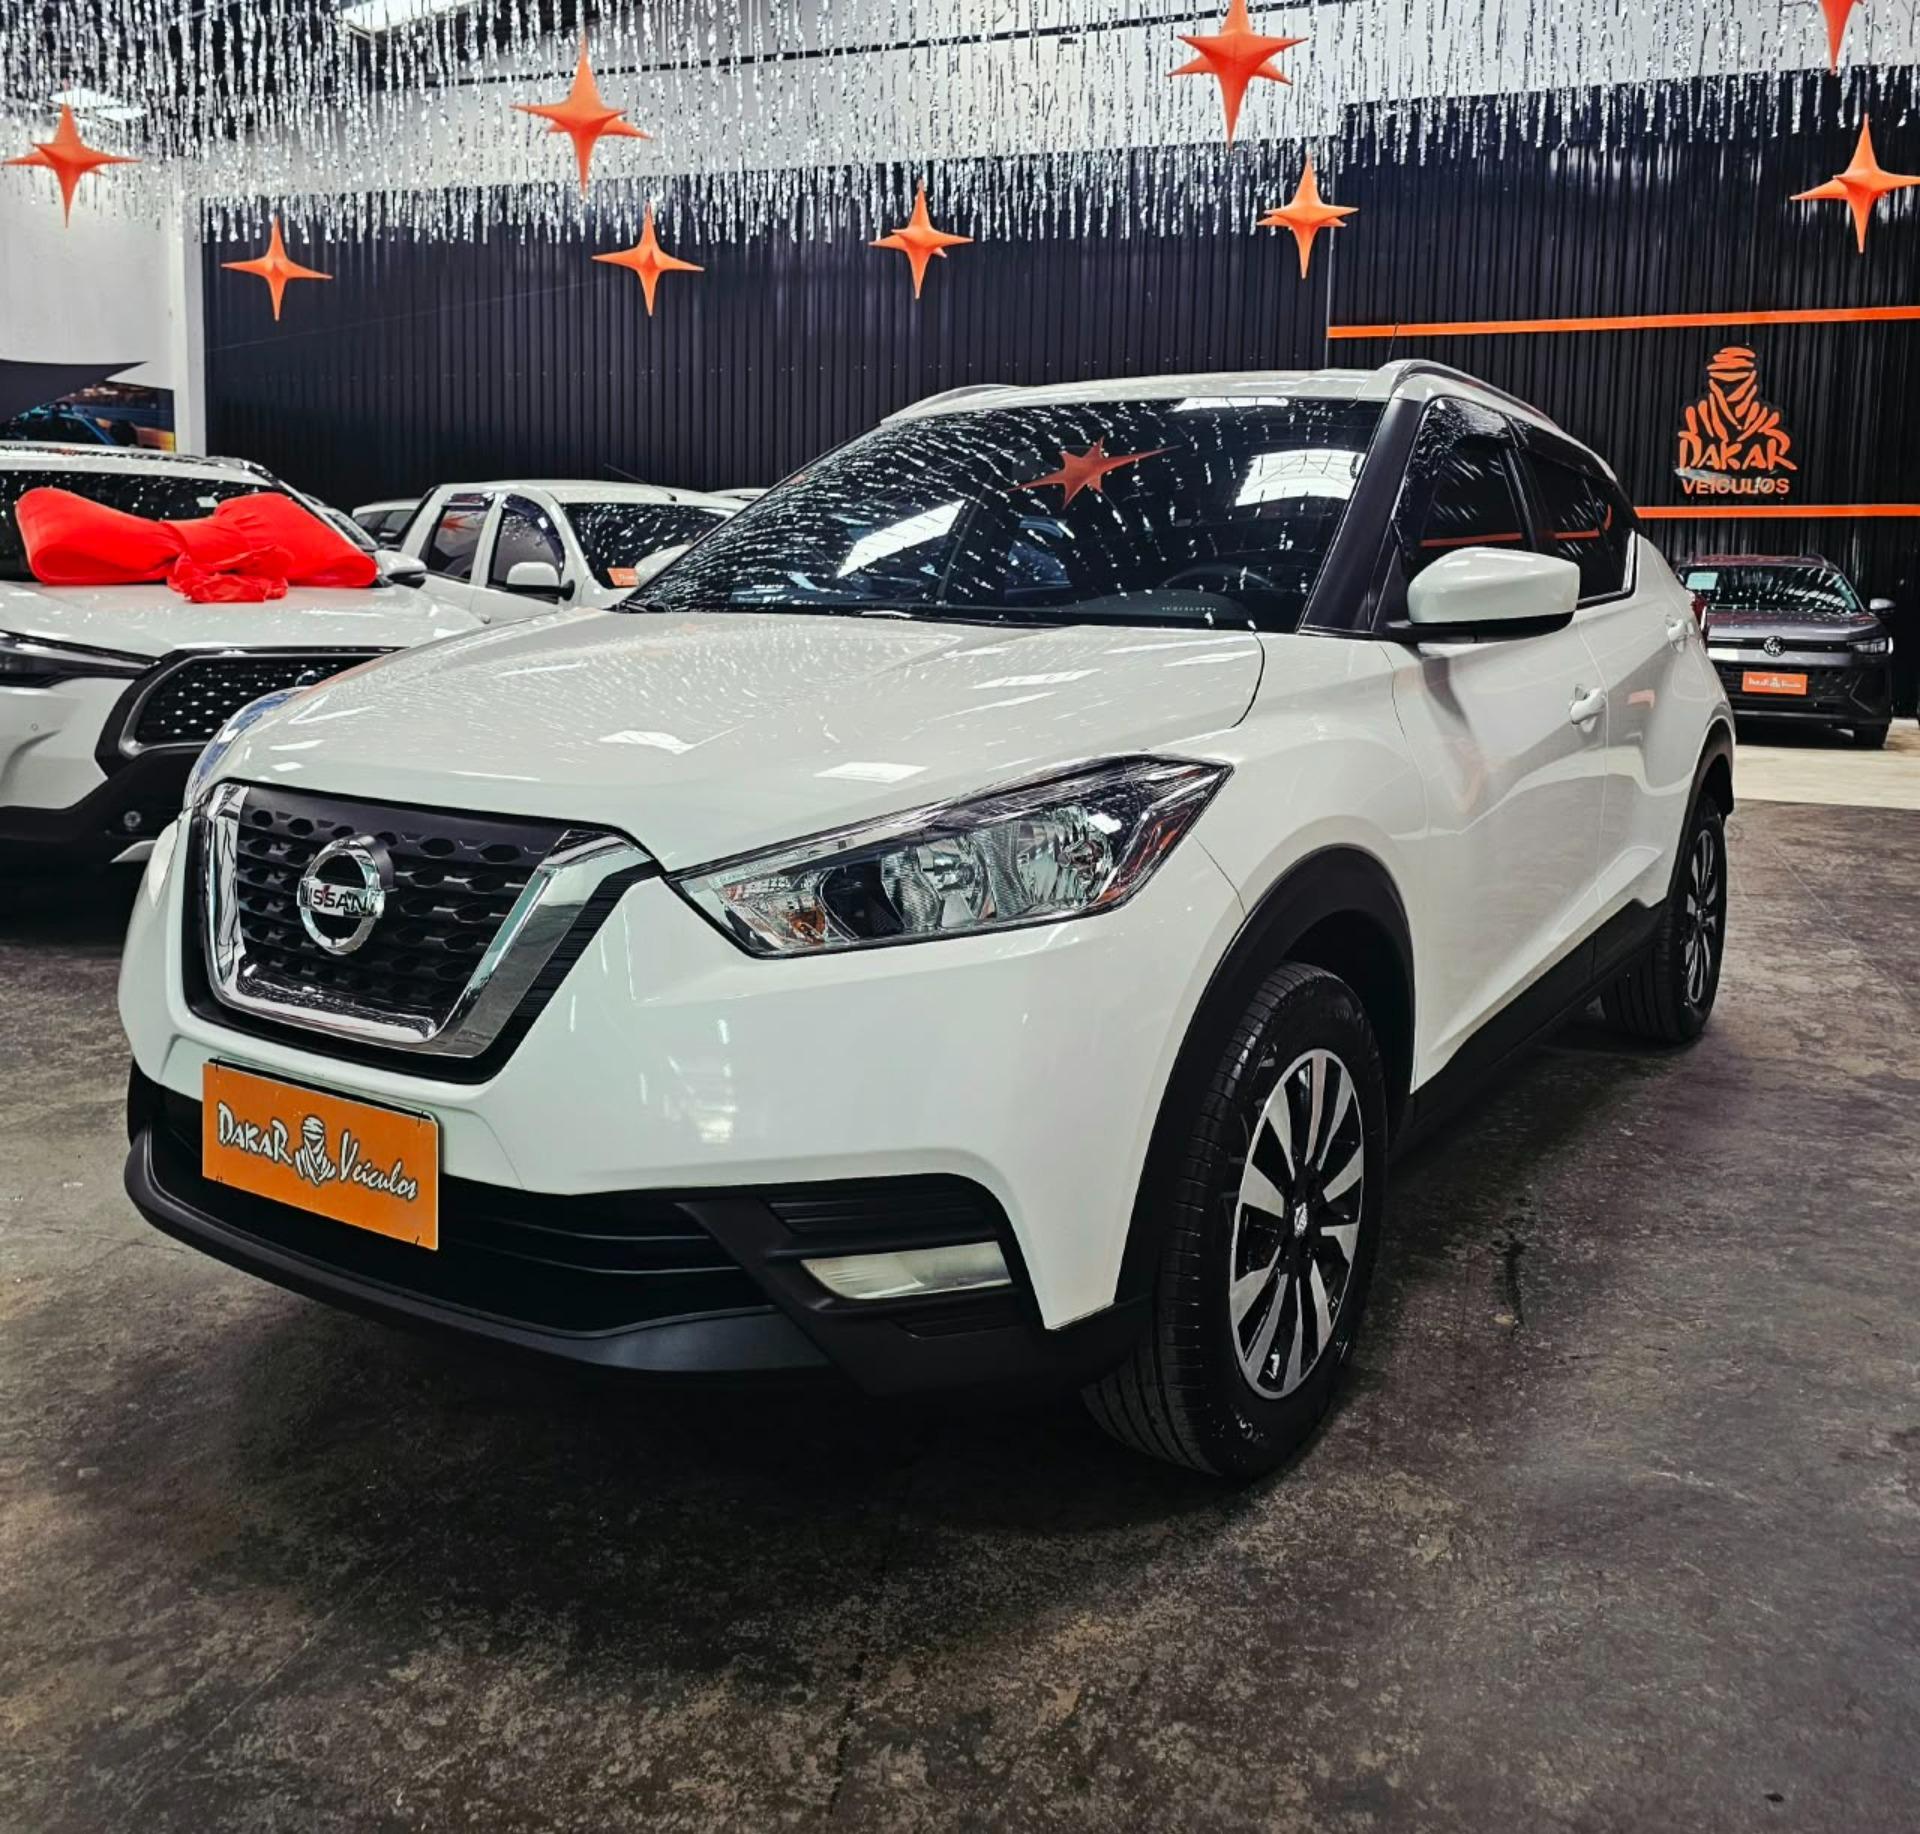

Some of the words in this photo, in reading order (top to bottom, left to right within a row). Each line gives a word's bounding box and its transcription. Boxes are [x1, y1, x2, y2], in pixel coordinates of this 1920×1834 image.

[1678, 428, 1798, 471] DAKAR
[217, 1101, 293, 1165] DAKAR
[339, 1130, 417, 1200] Veículos
